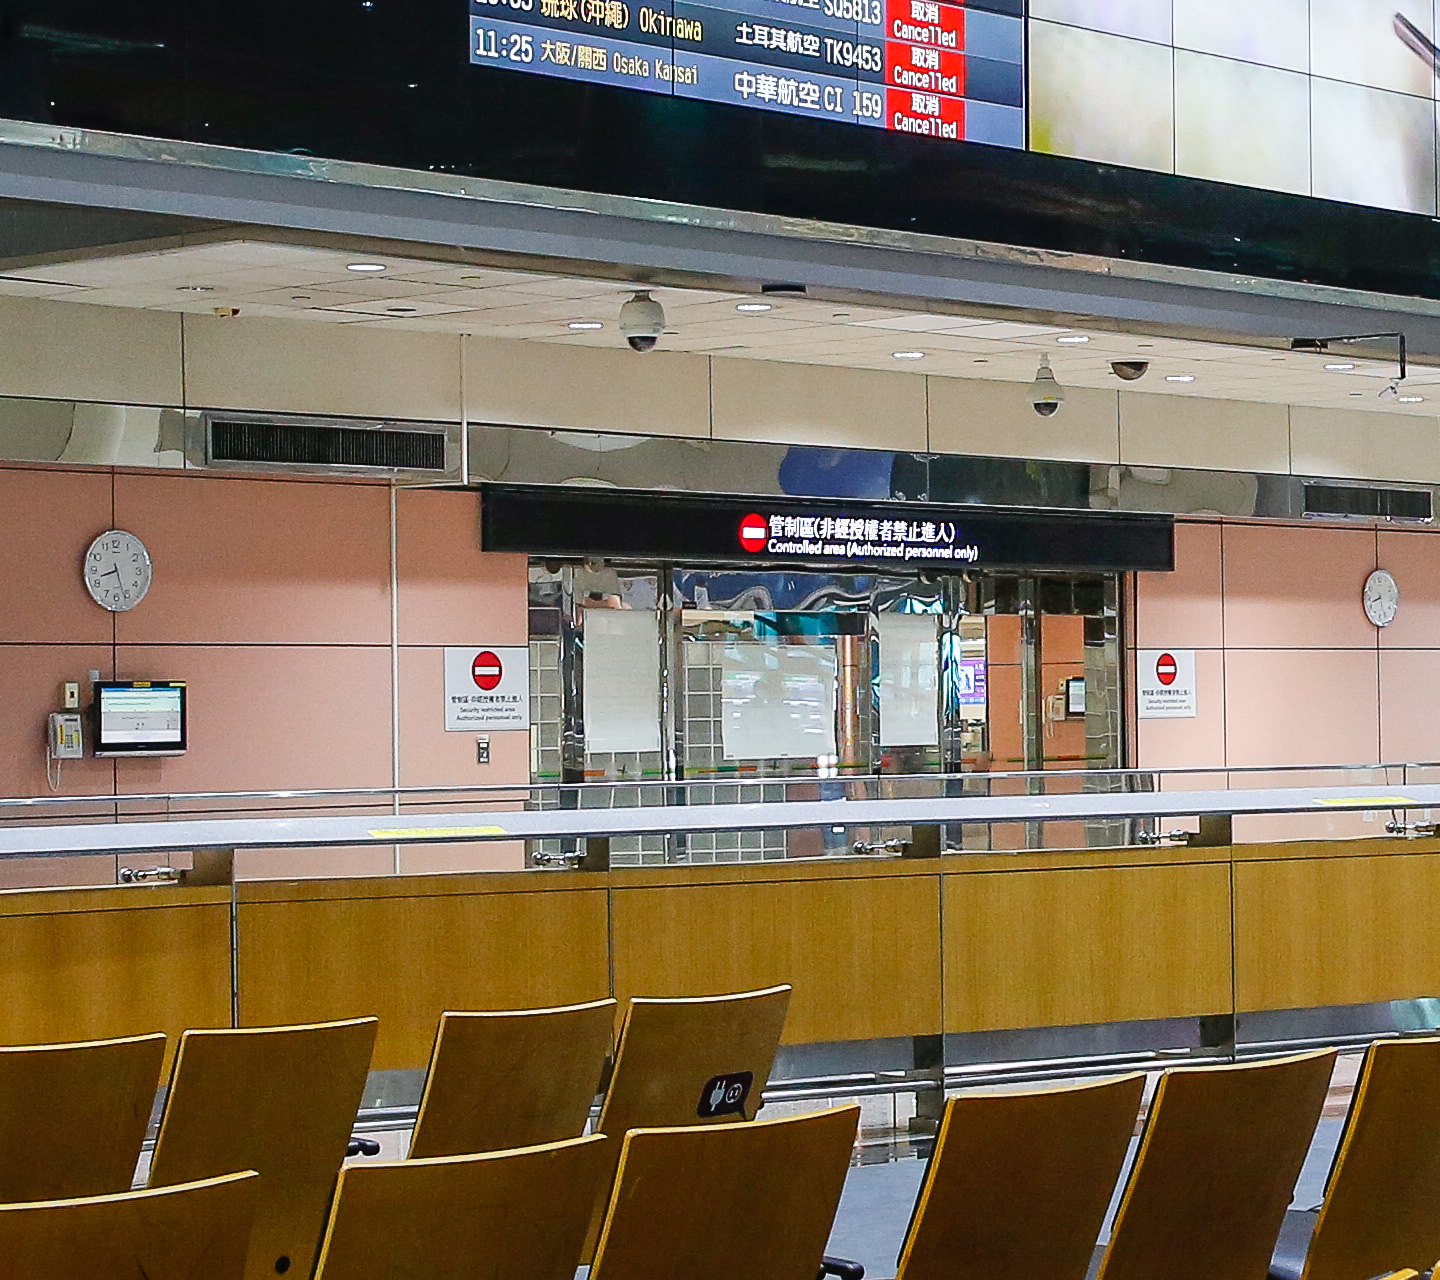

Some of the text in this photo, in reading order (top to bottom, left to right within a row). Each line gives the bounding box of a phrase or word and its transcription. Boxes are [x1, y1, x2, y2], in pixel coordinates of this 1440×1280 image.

[735, 22, 820, 57] 土耳其航空
[824, 37, 882, 72] TK9453
[476, 28, 533, 63] 11:25
[613, 52, 649, 77] Osaka
[735, 71, 820, 110] 中華航空
[824, 86, 843, 113] CI
[852, 85, 882, 119] 159
[767, 539, 980, 562] Controlled area (Authorized personnel only)
